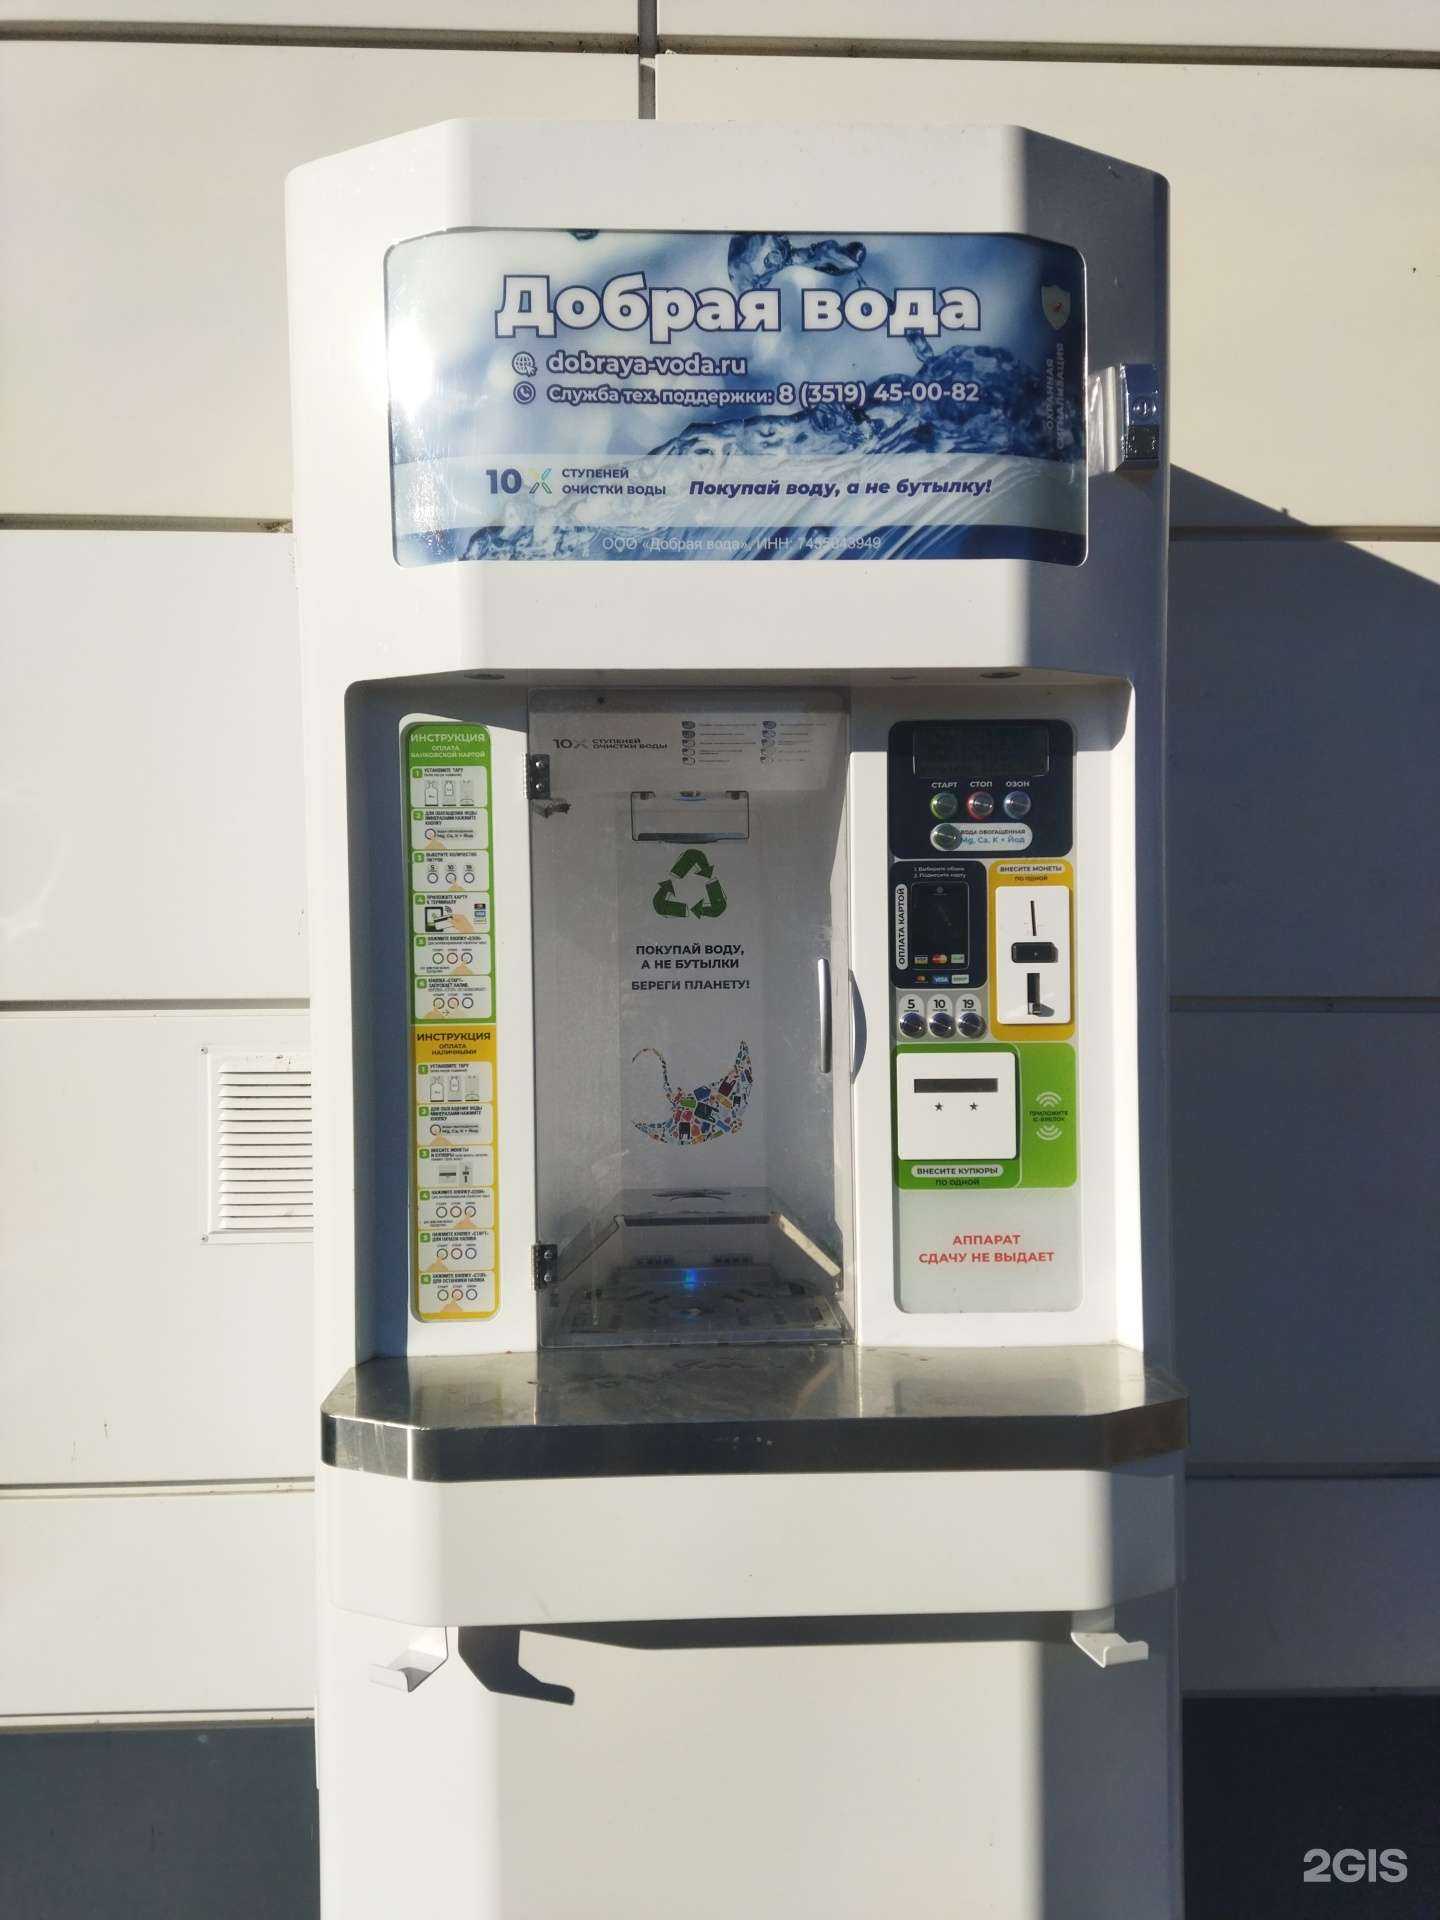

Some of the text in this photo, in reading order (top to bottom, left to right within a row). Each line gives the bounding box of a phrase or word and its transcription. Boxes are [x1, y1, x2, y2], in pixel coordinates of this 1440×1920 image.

[495, 271, 981, 344] Добрая вода
[547, 351, 747, 375] dobraya-voda.ru
[547, 382, 980, 405] Служба тех. поддержки: 8 (3519) 45-00-82
[1046, 358, 1055, 430] ОХРАННАЯ
[1056, 342, 1065, 450] СИГНАЛИЗАЦИЯ
[561, 467, 629, 479] СТУПЕНЕЙ
[561, 484, 667, 497] ОЧИСТКИ ВОДЫ
[689, 478, 992, 497] Покупай воду, а не бутылку!
[602, 536, 638, 550] ООО
[642, 536, 700, 552] «Добрая
[410, 733, 486, 743] ИНСТРУКЦИЯ
[931, 781, 958, 789] СТАРТ
[635, 943, 745, 956] ПОКУПАЙ ВОДУ,
[641, 959, 739, 970] А НЕ БУТЫЛКИ
[631, 979, 750, 991] БЕРЕГИ ПЛАНЕТУ!
[907, 999, 915, 1009] 5
[934, 999, 946, 1008] 10
[962, 999, 974, 1008] 19
[416, 1032, 491, 1042] ИНСТРУКЦИЯ
[917, 1166, 998, 1175] ВНЕСИТЕ КУПЮРЫ
[949, 1178, 980, 1186] ОДНОЙ
[952, 1235, 1021, 1245] АППАРАТ
[919, 1252, 1054, 1264] СДАЧУ НЕ ВЫДАЕТ
